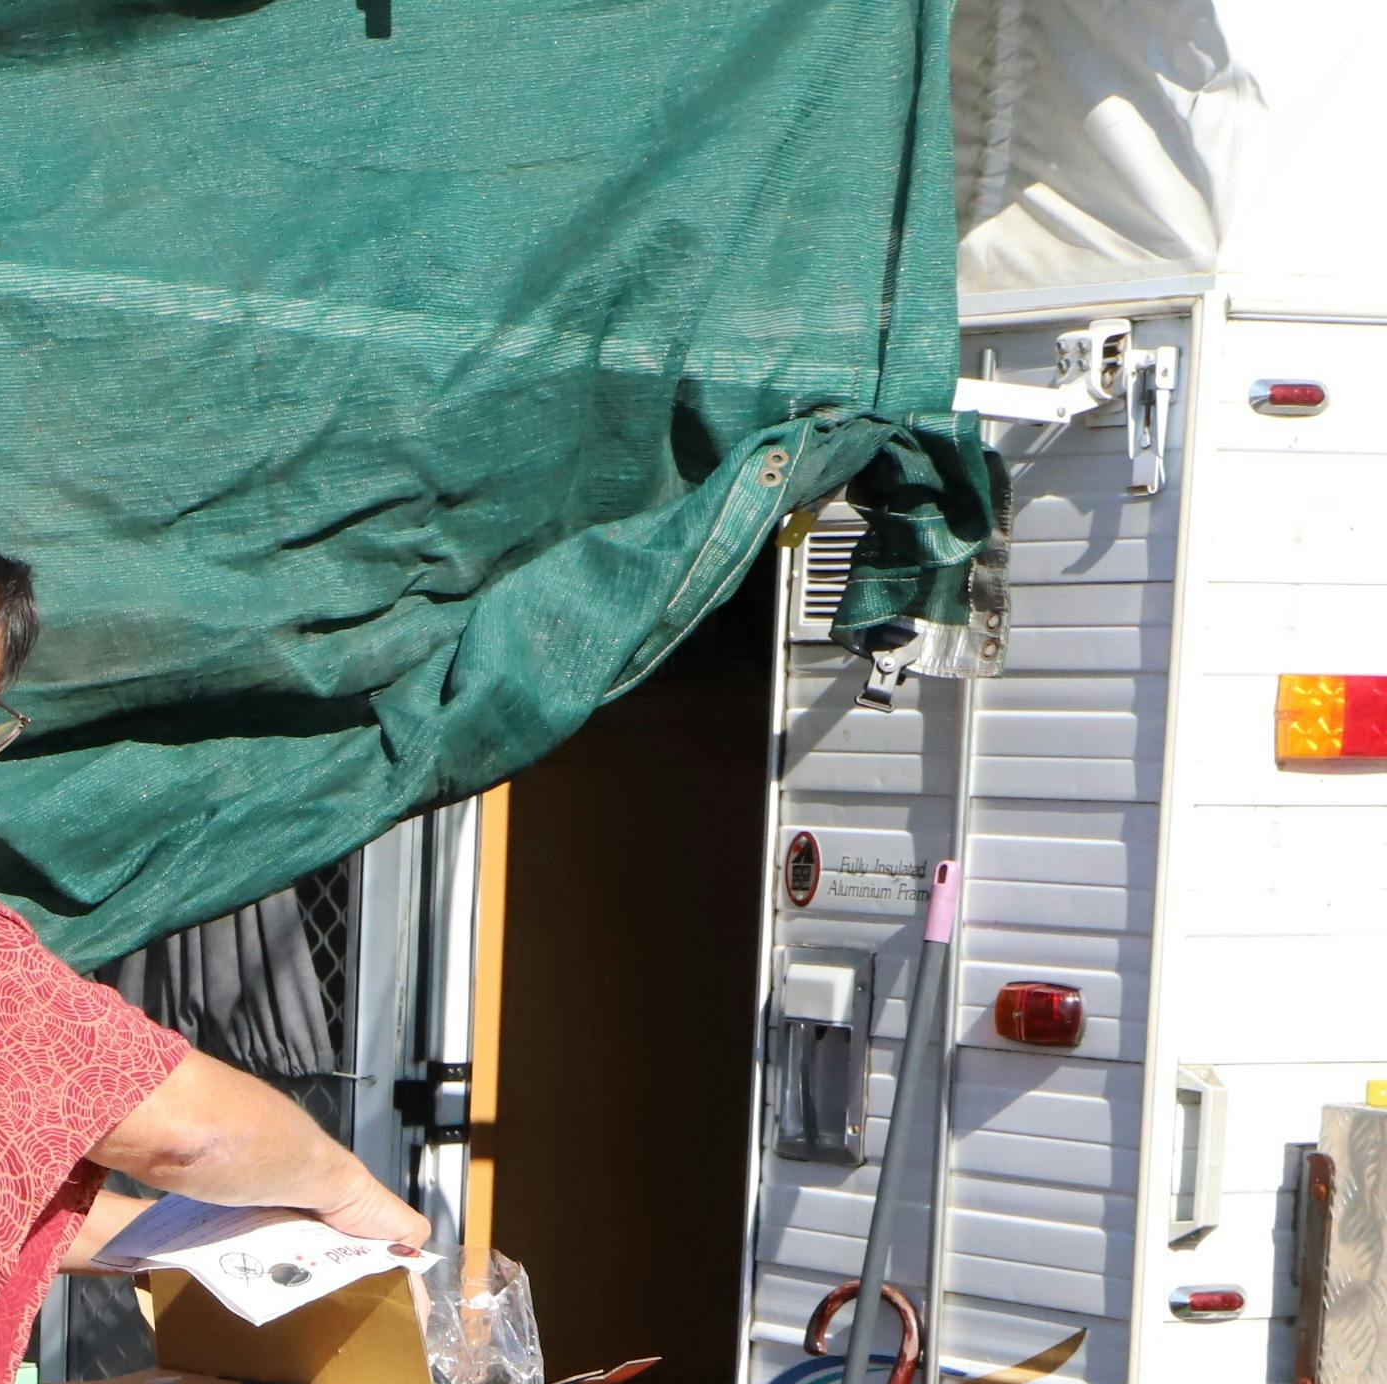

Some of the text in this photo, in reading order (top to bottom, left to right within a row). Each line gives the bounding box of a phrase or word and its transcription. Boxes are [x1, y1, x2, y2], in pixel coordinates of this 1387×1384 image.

[839, 856, 928, 879] Fully Insulated
[827, 879, 933, 903] Aluminium Fram
